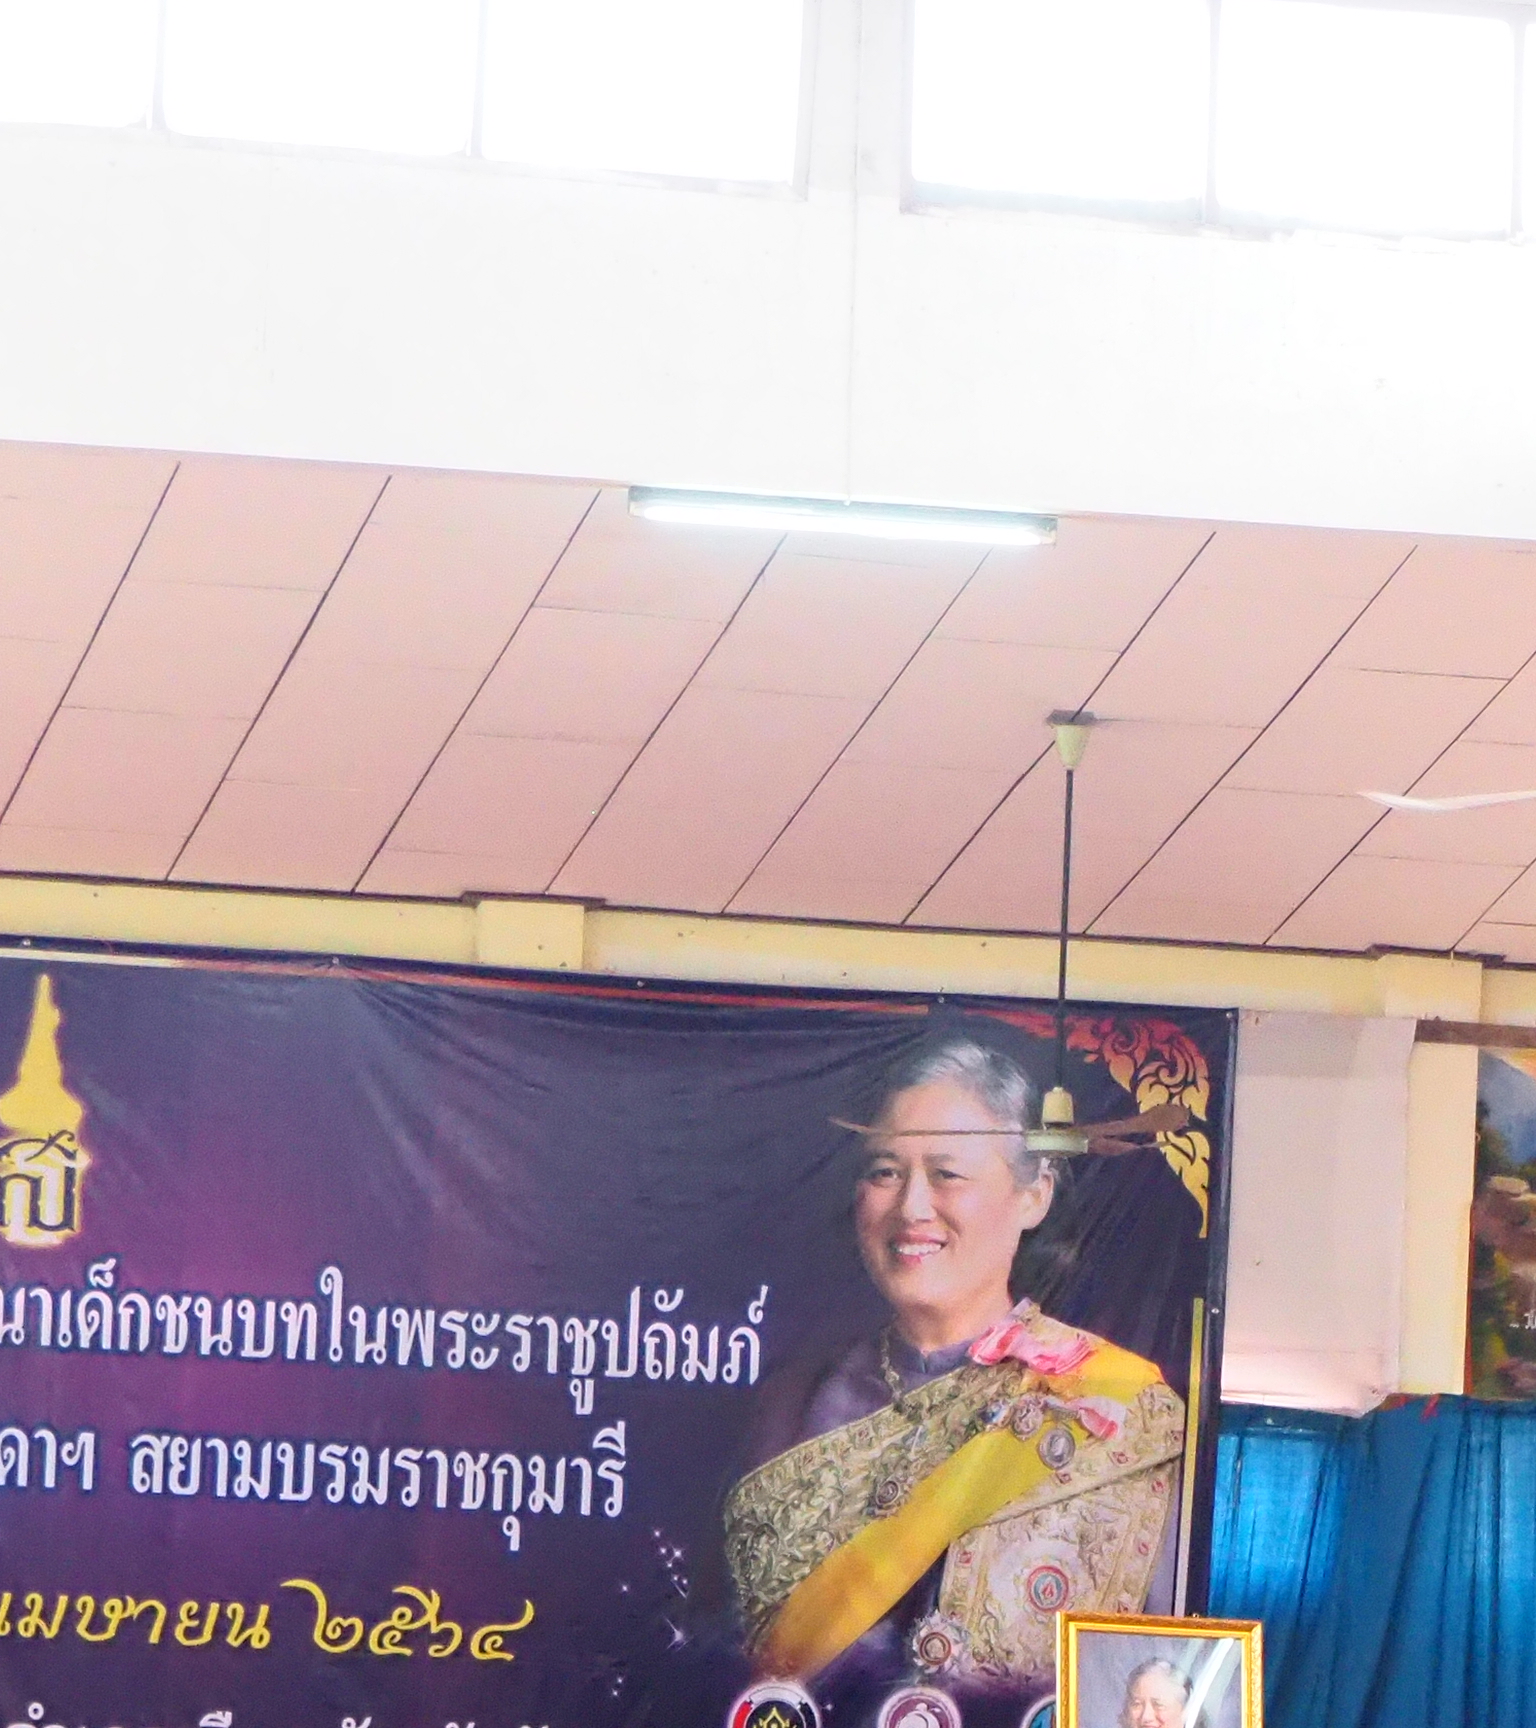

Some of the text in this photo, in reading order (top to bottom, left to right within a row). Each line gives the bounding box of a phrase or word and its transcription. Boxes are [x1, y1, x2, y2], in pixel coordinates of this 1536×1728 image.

[130, 1422, 628, 1551] สยามบรมราชกุมารี
[281, 1578, 535, 1662] ๒๕๖๔
